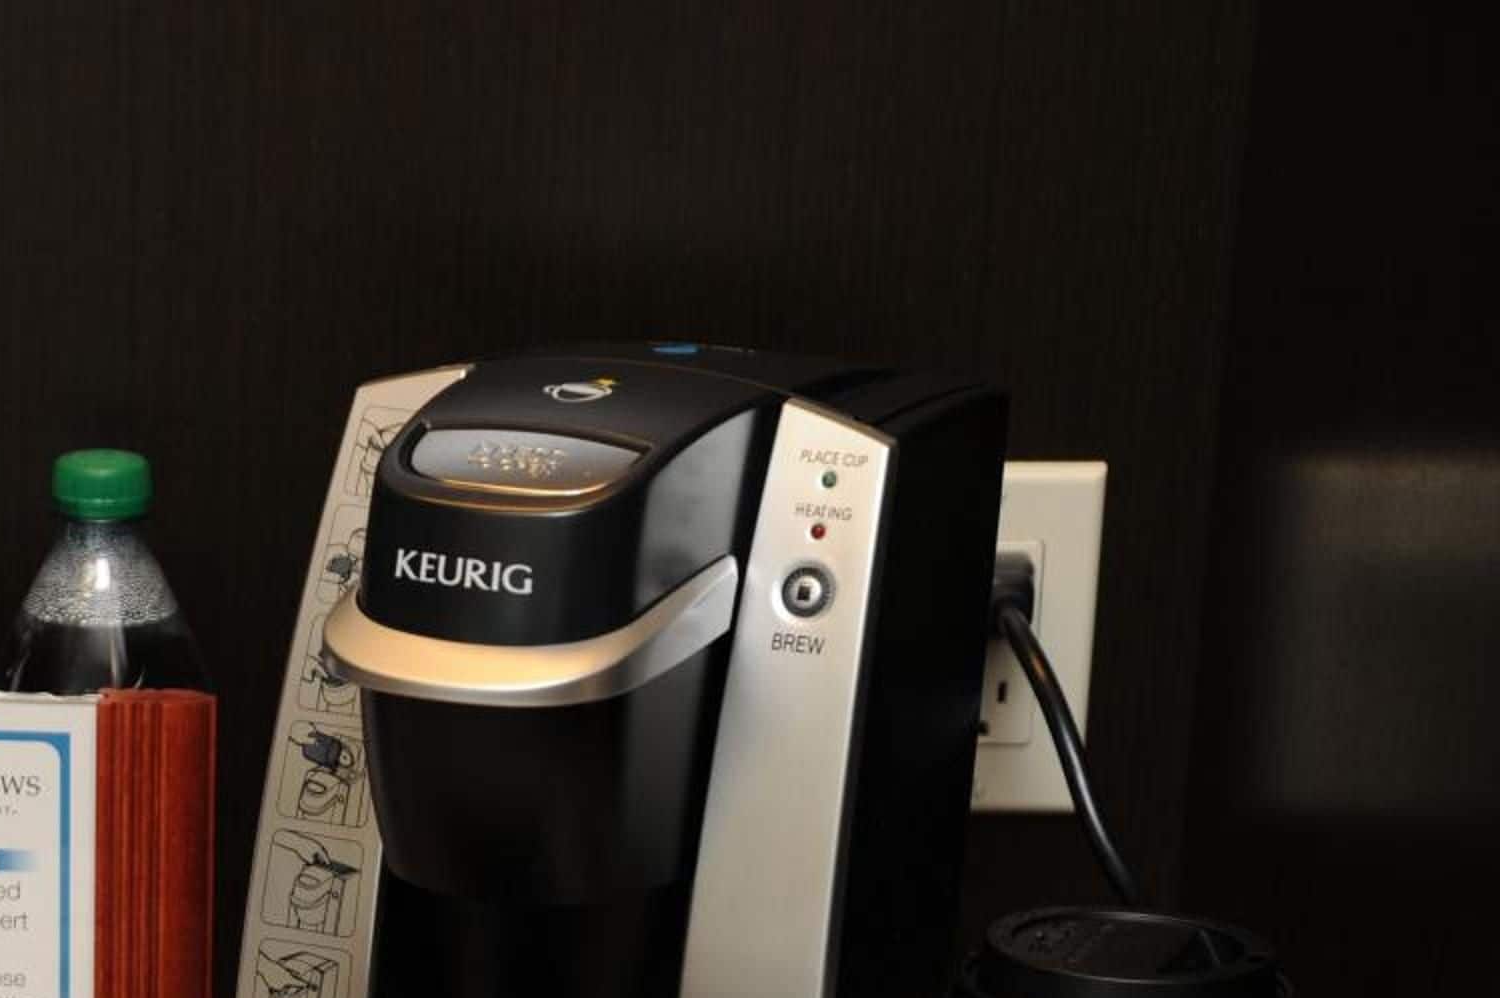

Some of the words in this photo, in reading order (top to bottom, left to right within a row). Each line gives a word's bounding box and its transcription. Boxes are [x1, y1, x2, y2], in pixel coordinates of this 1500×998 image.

[800, 449, 839, 466] PLACE
[842, 453, 869, 468] CUP
[796, 502, 853, 521] HEATING
[394, 548, 533, 595] KEURIG
[771, 632, 826, 655] BREW
